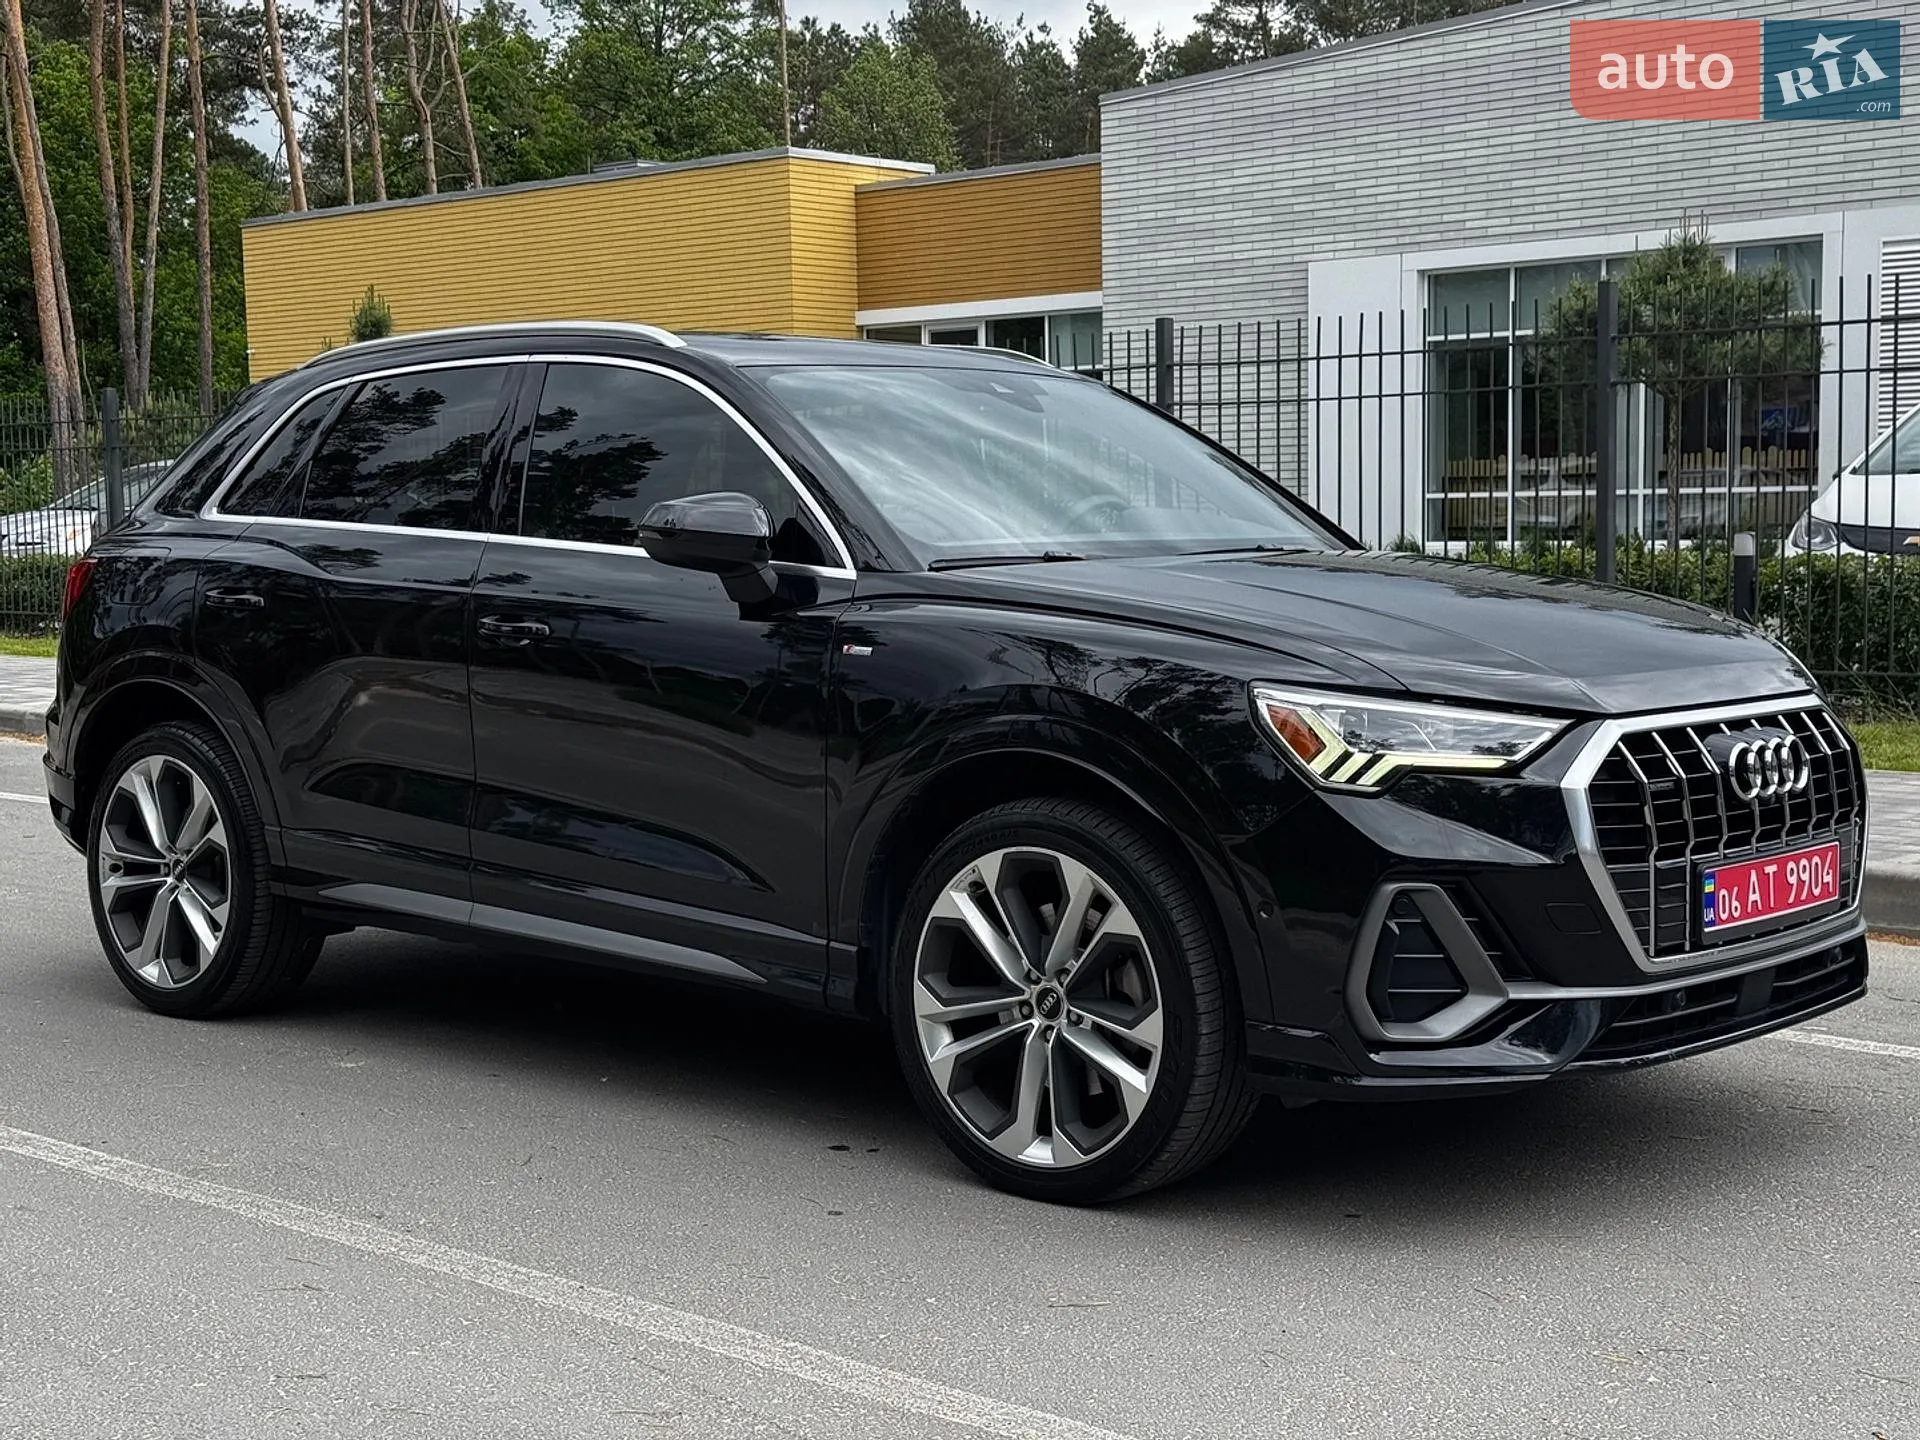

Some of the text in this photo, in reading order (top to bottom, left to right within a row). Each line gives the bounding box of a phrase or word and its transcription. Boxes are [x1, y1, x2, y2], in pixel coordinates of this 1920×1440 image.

[1718, 851, 1833, 921] 06 AT 9904
[1704, 908, 1715, 922] UA
